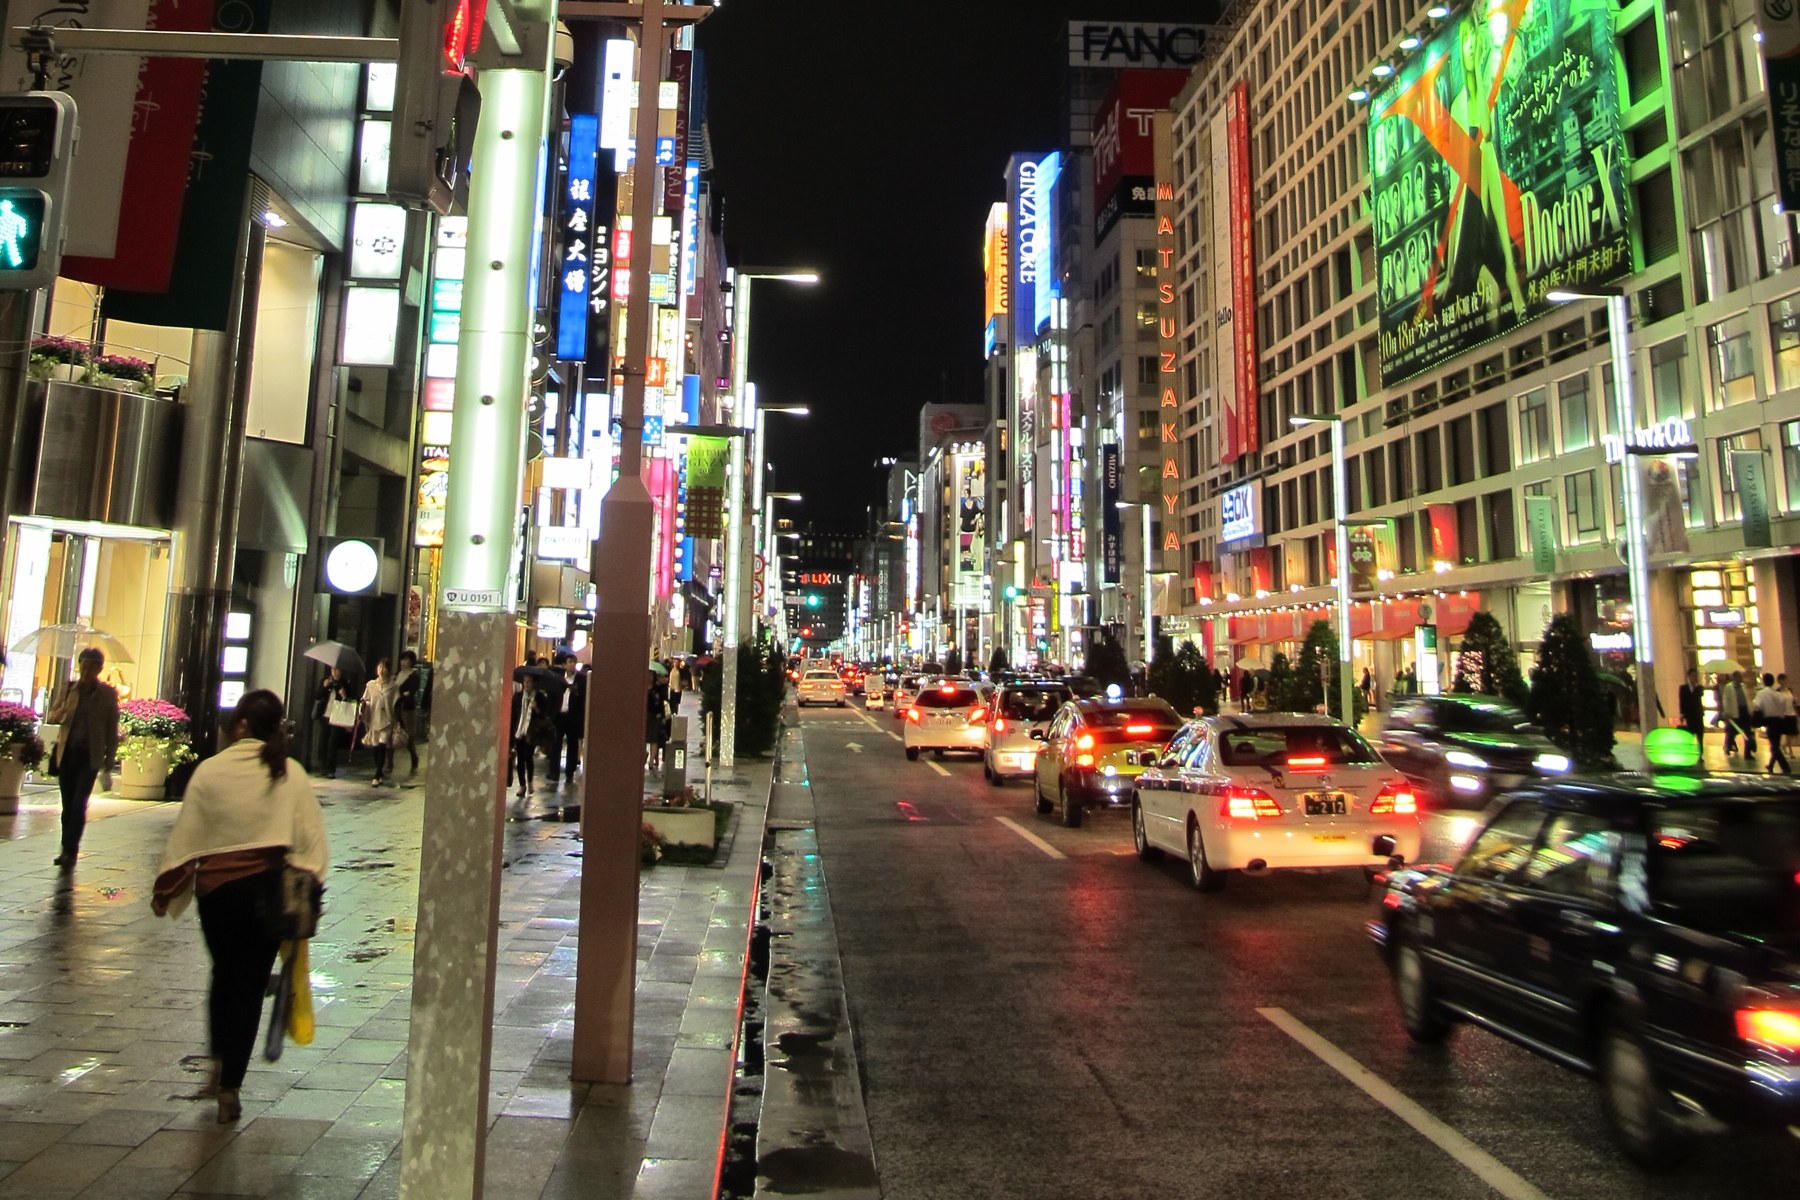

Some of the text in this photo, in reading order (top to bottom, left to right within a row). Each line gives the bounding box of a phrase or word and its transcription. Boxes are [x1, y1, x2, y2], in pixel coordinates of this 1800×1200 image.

[1019, 161, 1039, 284] GINZA CORE
[1520, 137, 1623, 279] Doctor-X
[590, 247, 609, 314] ヨシノヤ
[1157, 182, 1179, 551] MATSUZAKAYA
[689, 457, 724, 467] GINZA
[1108, 454, 1117, 489] MIZUHO
[460, 593, 468, 602] U
[470, 593, 492, 603] 0191
[812, 573, 842, 584] LIXIL
